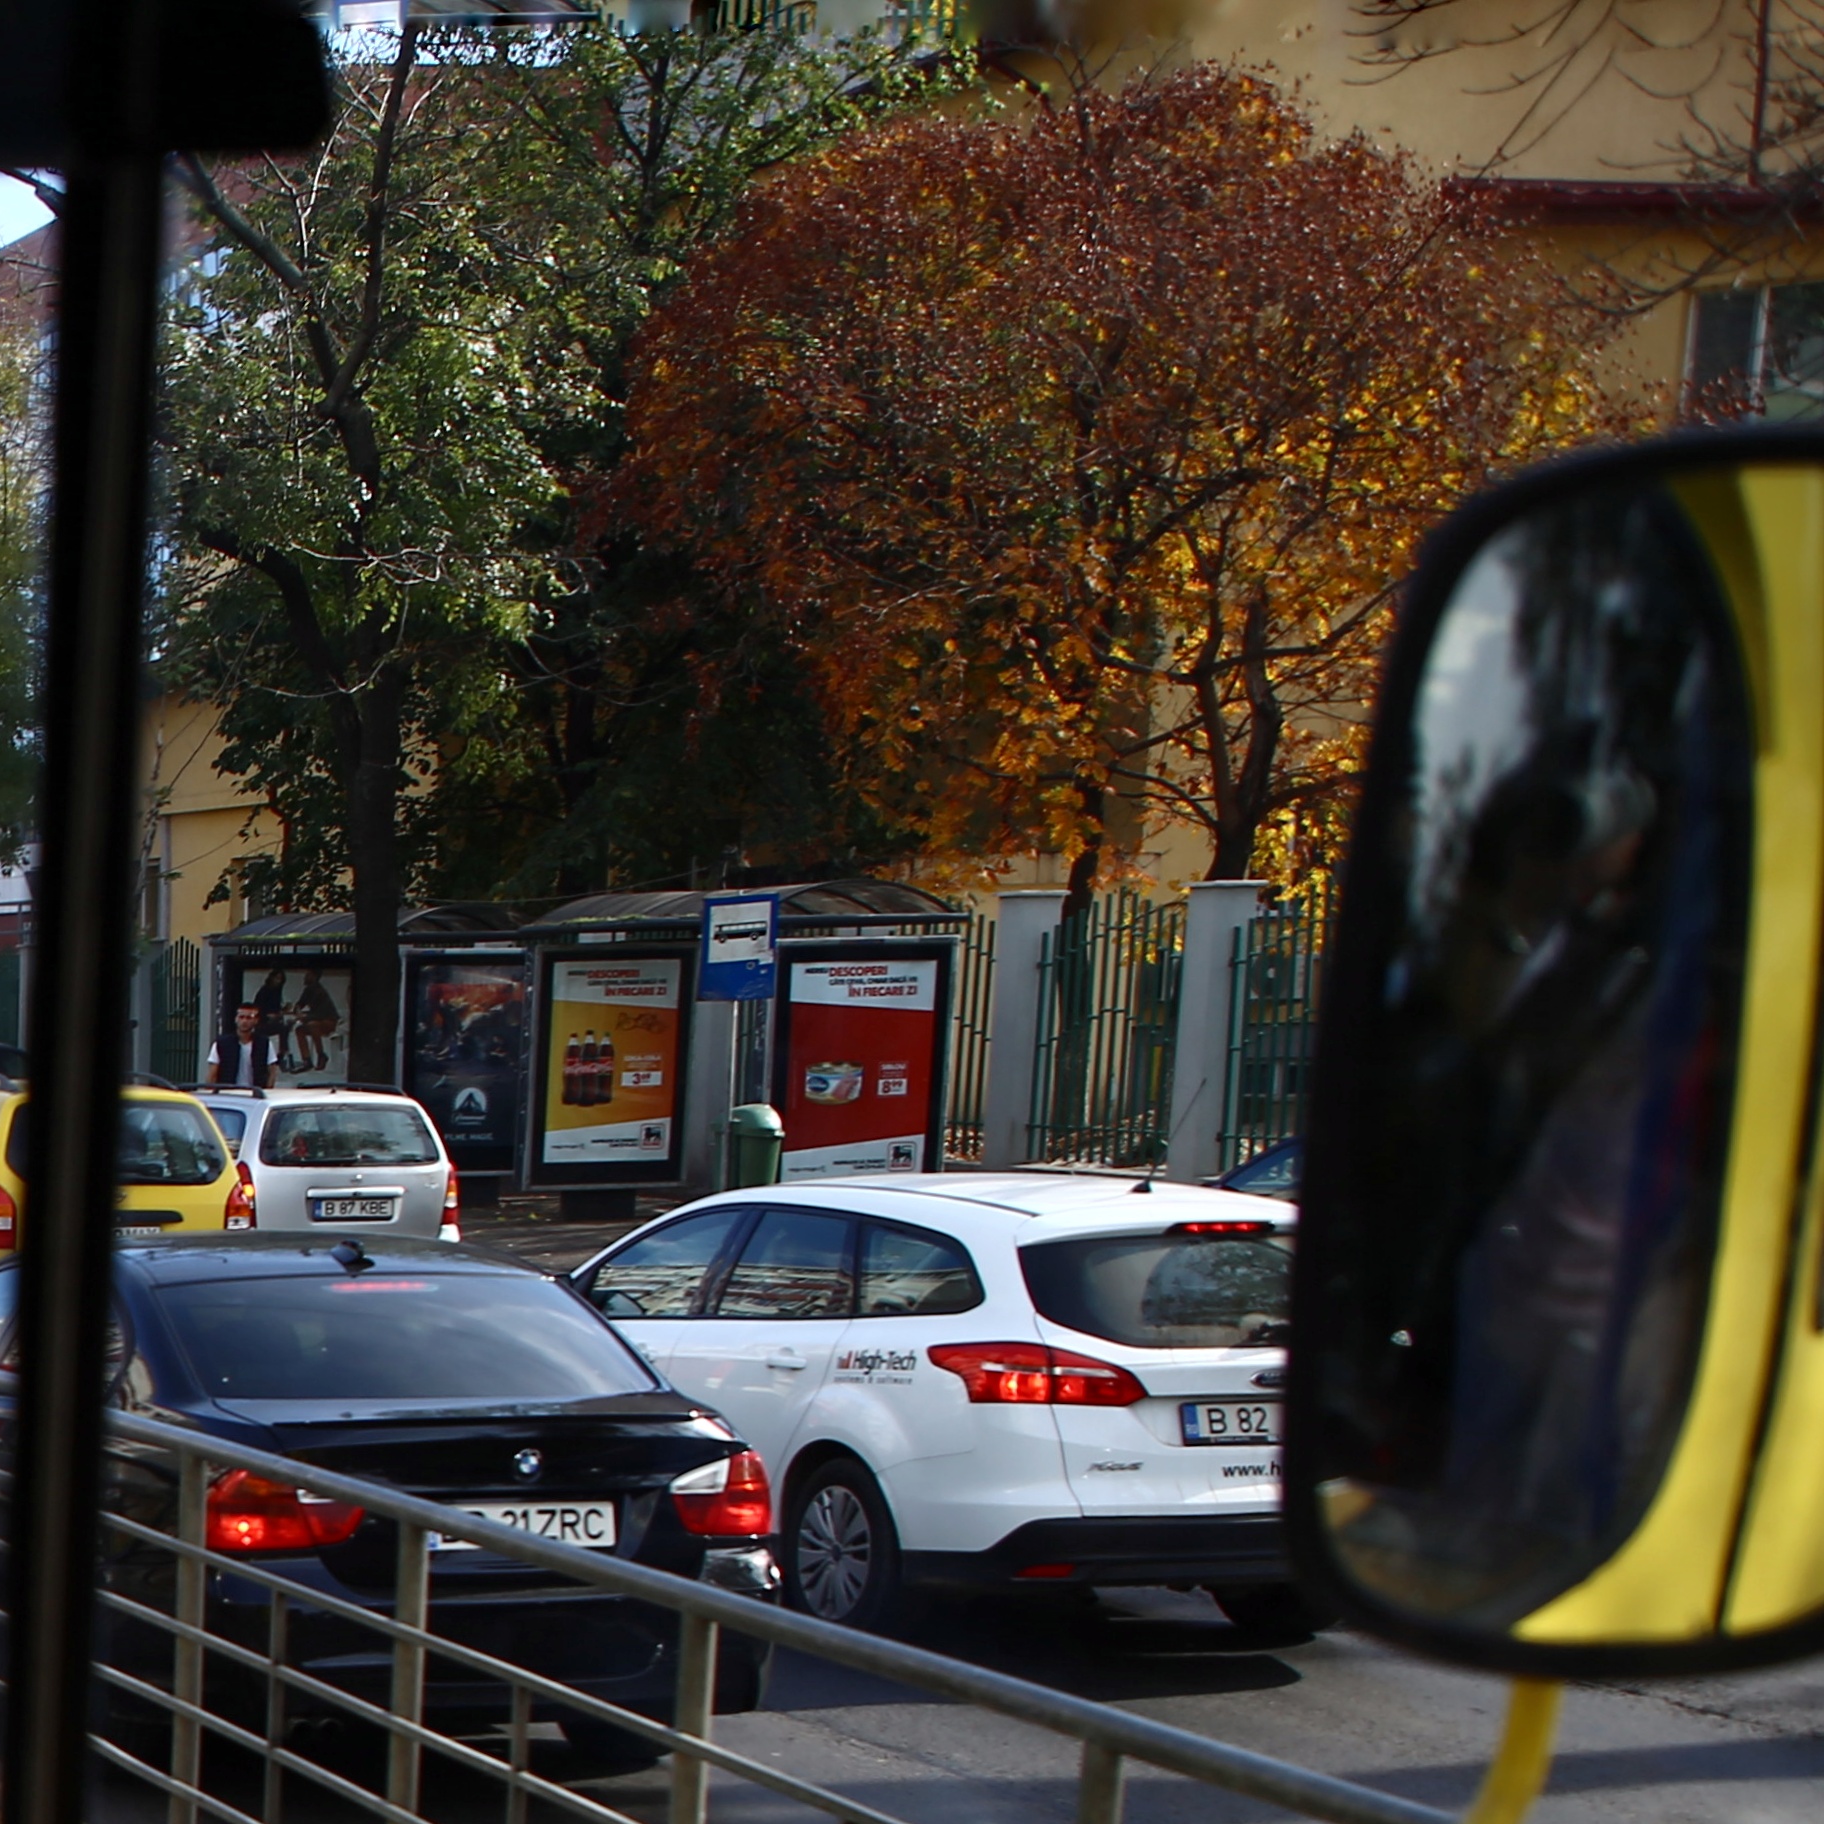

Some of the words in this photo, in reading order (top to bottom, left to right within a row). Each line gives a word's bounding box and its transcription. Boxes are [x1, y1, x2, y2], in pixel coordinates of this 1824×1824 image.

[829, 965, 888, 977] DESCOPERI
[848, 984, 862, 998] ÎN
[863, 985, 904, 997] FIECARE
[906, 985, 918, 996] ZI
[325, 1201, 335, 1215] B
[339, 1201, 355, 1215] 87
[359, 1200, 389, 1215] KBE
[852, 1349, 917, 1375] High-Tech
[876, 1376, 913, 1384] software
[1206, 1407, 1227, 1434] B
[1236, 1406, 1269, 1433] 82
